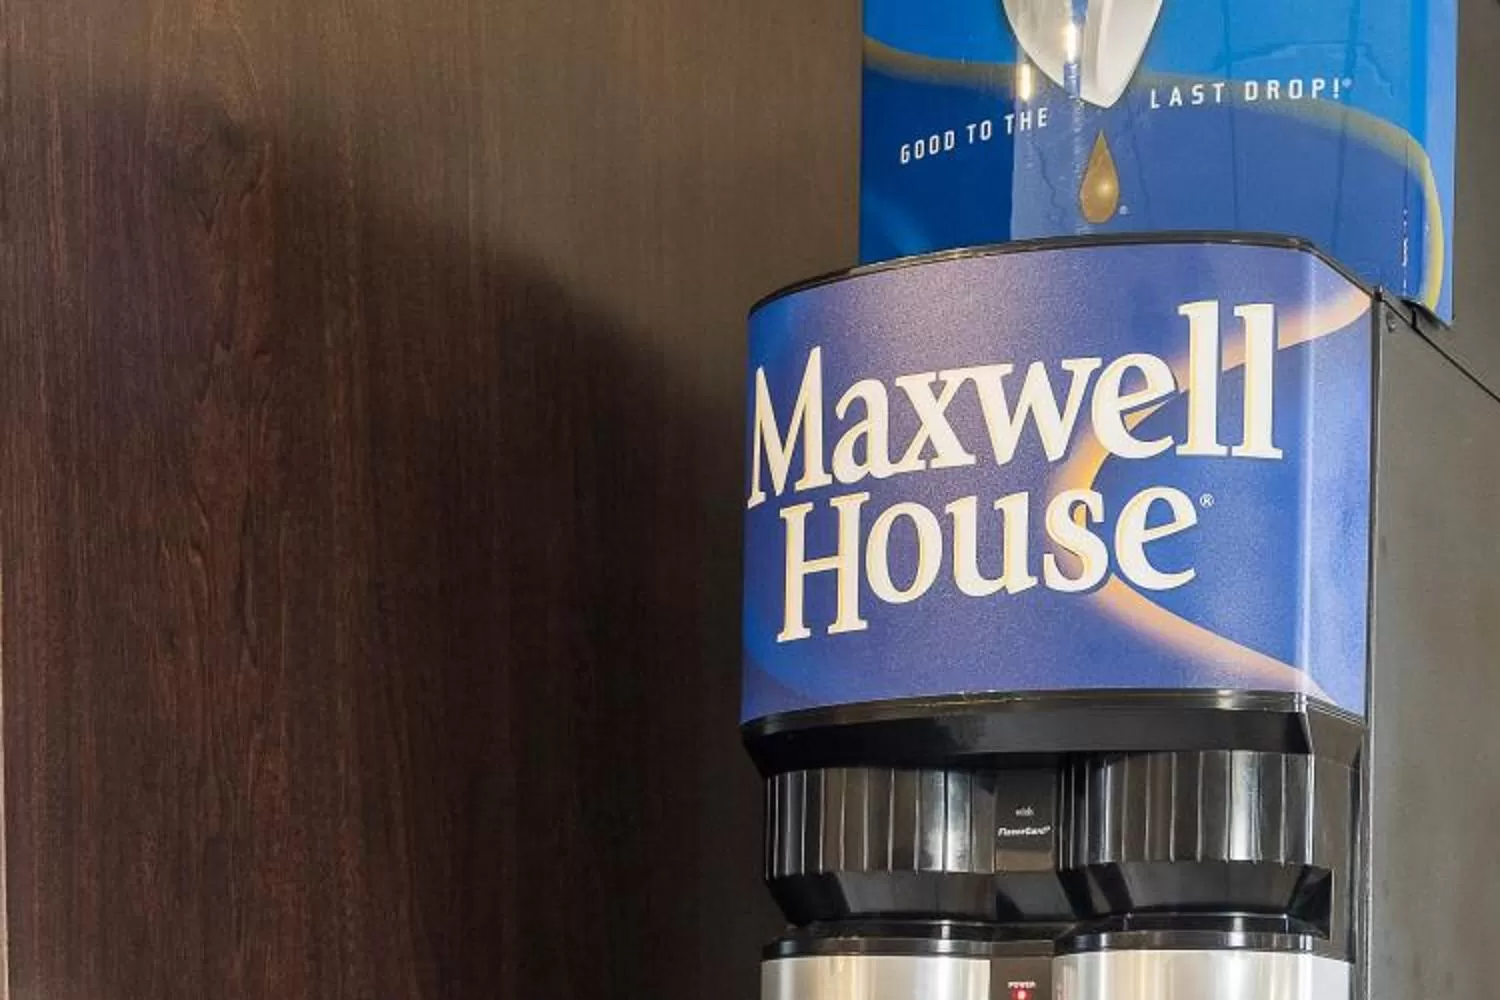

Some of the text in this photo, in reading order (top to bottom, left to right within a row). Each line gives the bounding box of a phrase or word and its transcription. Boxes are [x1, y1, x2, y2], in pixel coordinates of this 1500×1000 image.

[1150, 77, 1340, 109] LAST DROP!
[900, 106, 1049, 165] GOOD TO THE
[747, 299, 1283, 508] Maxwell
[777, 485, 1199, 643] House
[1007, 981, 1036, 989] POWER
